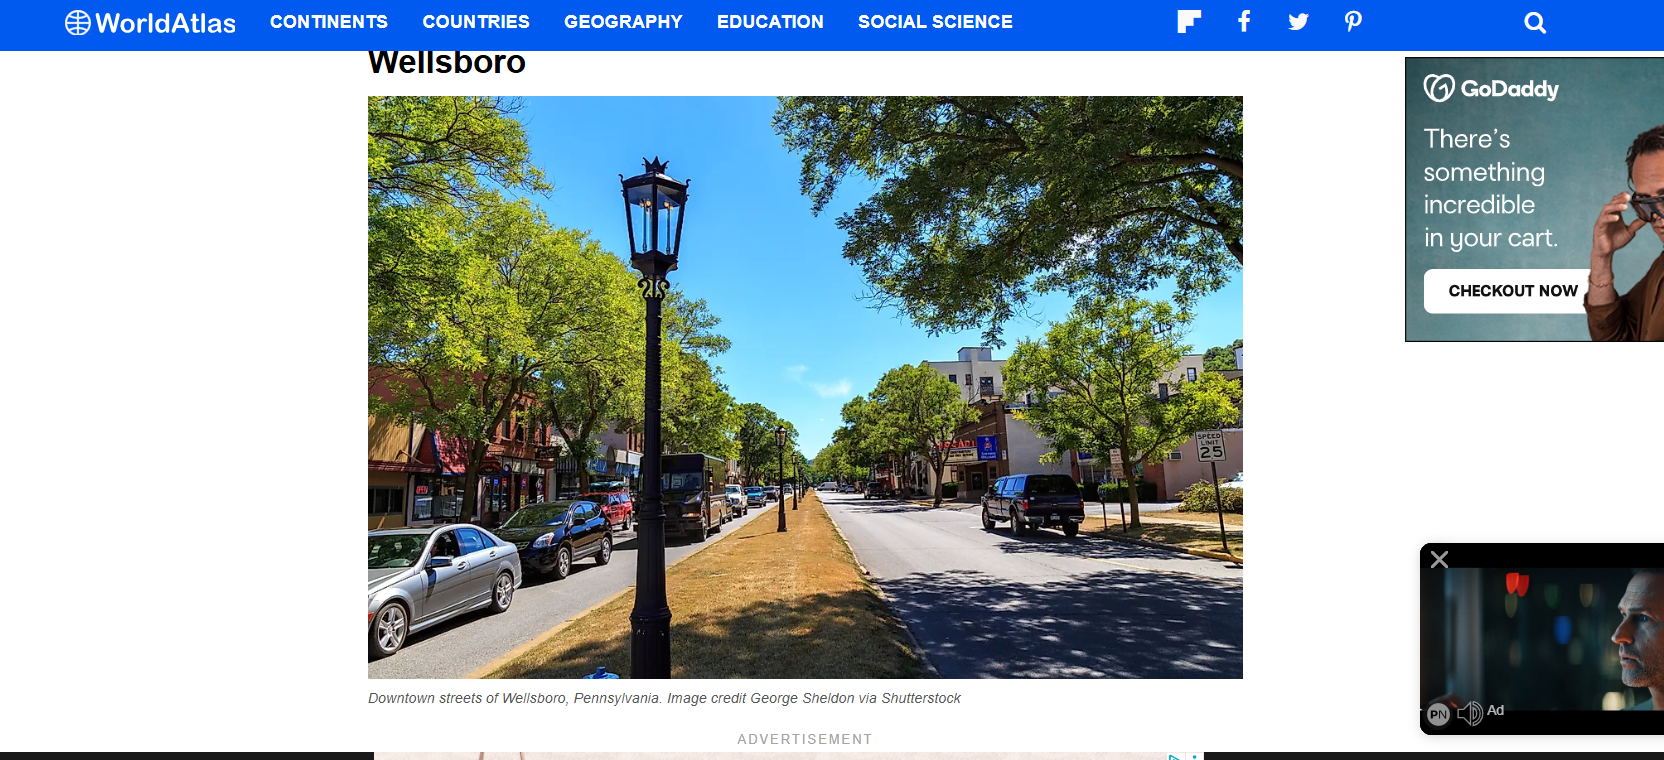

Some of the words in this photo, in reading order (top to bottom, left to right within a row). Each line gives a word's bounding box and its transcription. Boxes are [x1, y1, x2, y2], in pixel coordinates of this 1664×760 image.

[95, 12, 236, 34] WorldAtlas
[270, 14, 389, 29] CONTINENTS
[422, 14, 531, 29] COUNTRIES
[564, 14, 684, 29] GEOGRAPHY
[717, 14, 824, 29] EDUCATION
[858, 14, 928, 29] SOCIAL
[931, 14, 1014, 29] SCIENCE
[367, 51, 526, 74] Wellsboro
[1460, 79, 1560, 102] GoDaddy
[1423, 128, 1511, 149] There’s
[1424, 161, 1545, 187] something
[1424, 194, 1535, 215] incredible
[1425, 227, 1443, 247] in
[1450, 232, 1502, 253] your
[1508, 229, 1558, 247] cart.
[1448, 284, 1536, 298] CHECKOUT
[1539, 284, 1579, 298] NOW
[1199, 445, 1223, 459] 25
[1430, 709, 1447, 720] PN
[1486, 704, 1505, 716] Ad
[736, 733, 873, 745] ADVERTISEMENT
